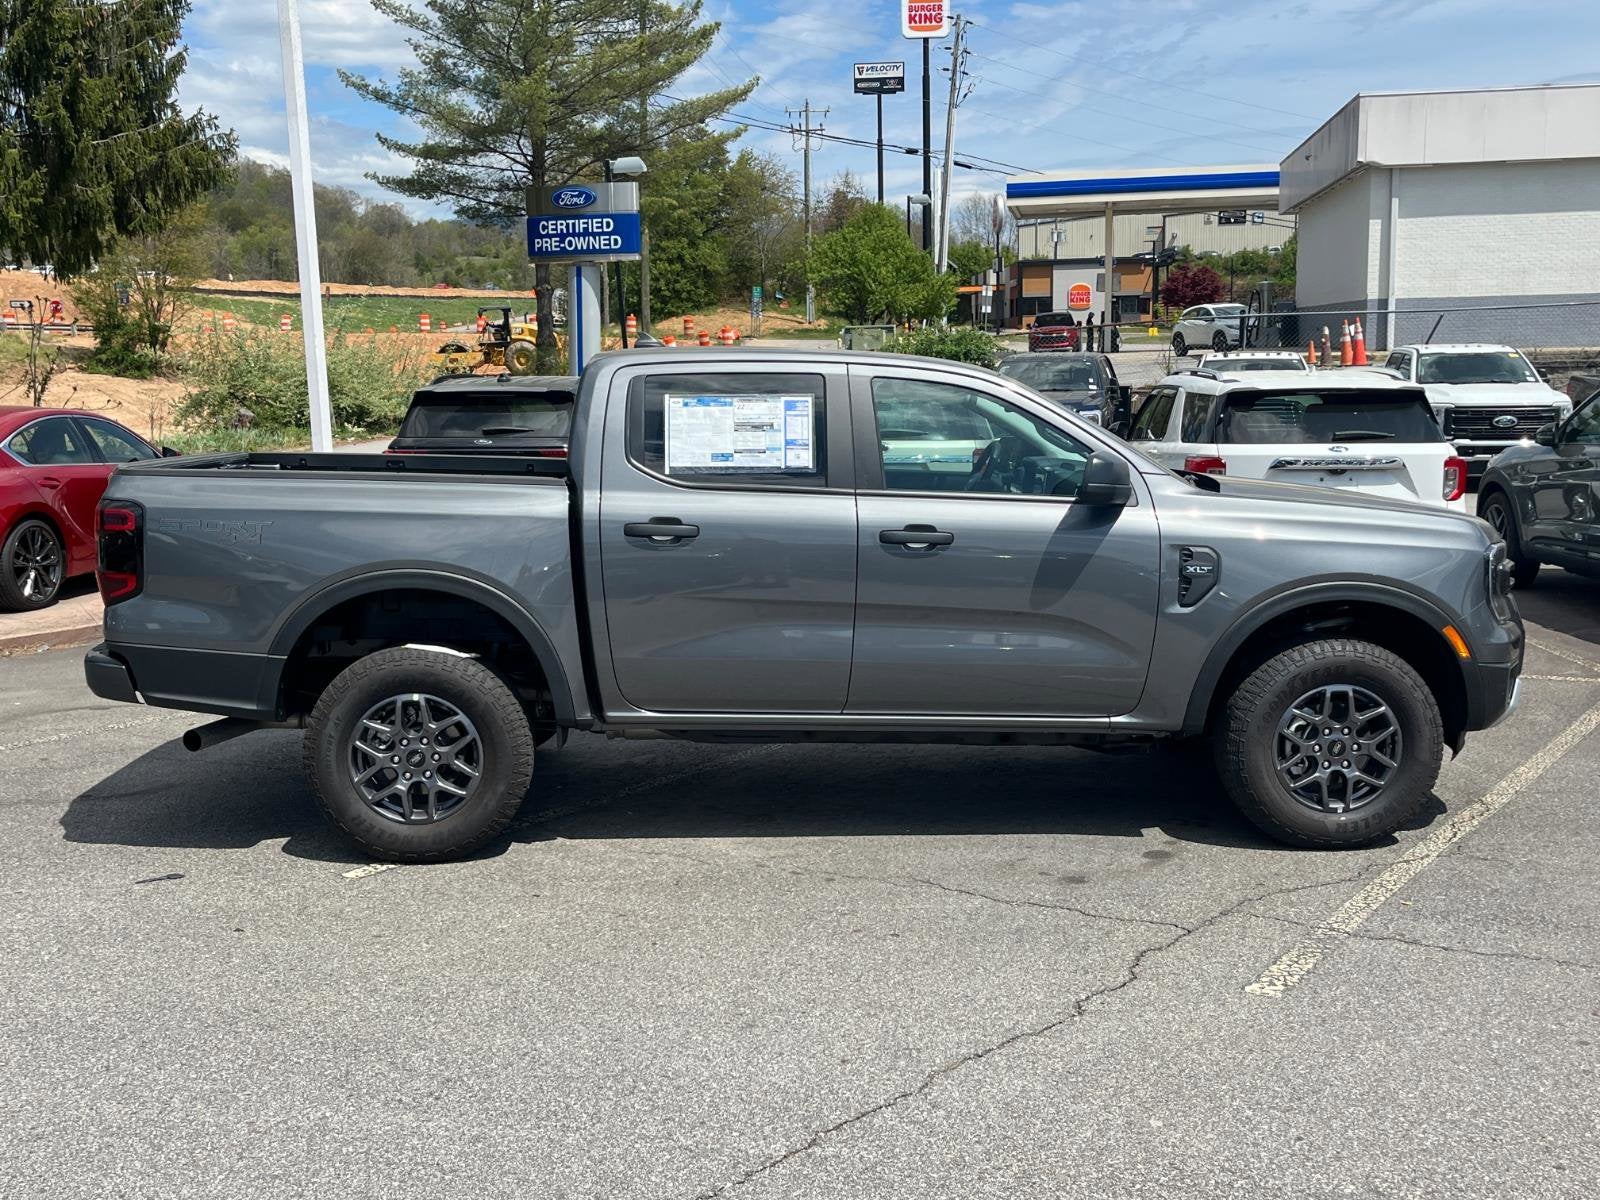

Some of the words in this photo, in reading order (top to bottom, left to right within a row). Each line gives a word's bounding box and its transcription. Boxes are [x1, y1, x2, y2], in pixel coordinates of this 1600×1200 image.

[908, 4, 943, 12] BURGER
[908, 13, 943, 24] KING
[559, 191, 586, 206] Ford
[539, 218, 614, 235] CERTIFIED
[534, 235, 622, 252] PRE-OWNED
[1186, 565, 1213, 573] XLT
